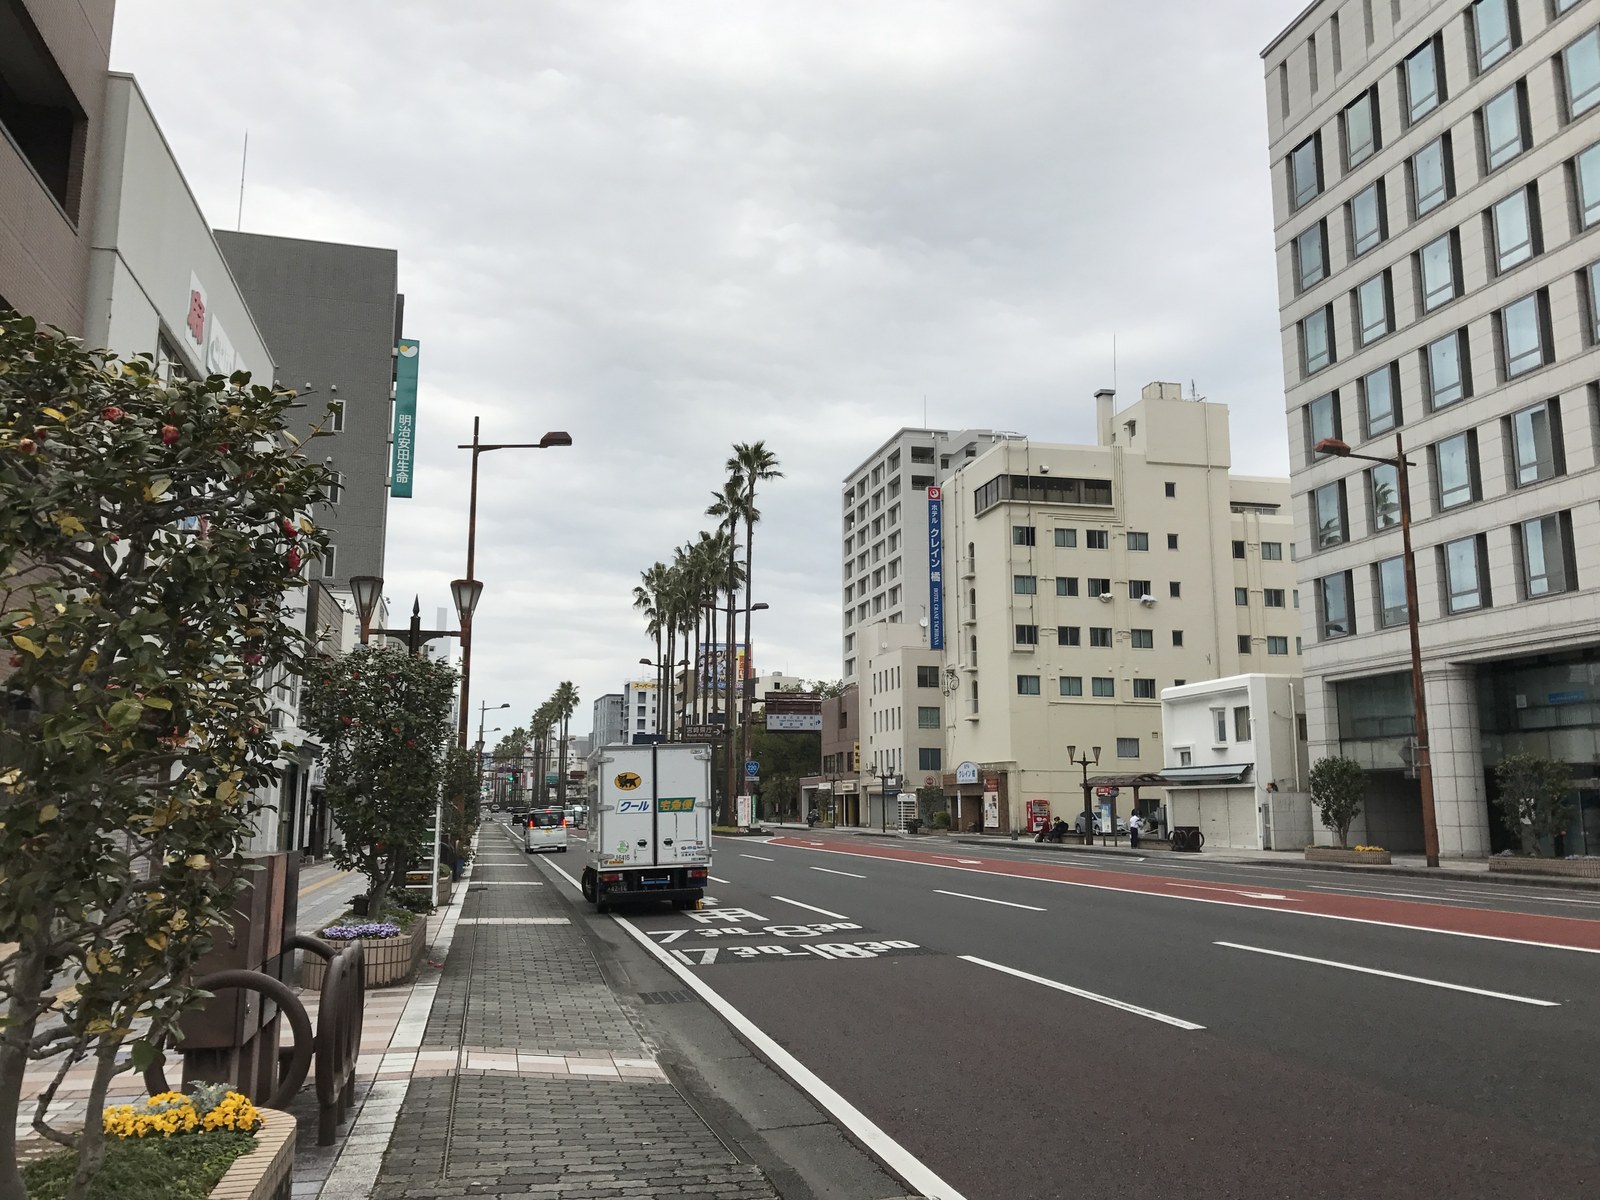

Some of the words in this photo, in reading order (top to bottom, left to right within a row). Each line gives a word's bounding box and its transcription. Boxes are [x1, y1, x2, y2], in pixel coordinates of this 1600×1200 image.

[397, 415, 411, 483] 明治安田生命
[931, 528, 940, 568] クレイン
[931, 572, 940, 582] 橘
[620, 801, 650, 812] クール
[660, 799, 693, 811] 宅急便
